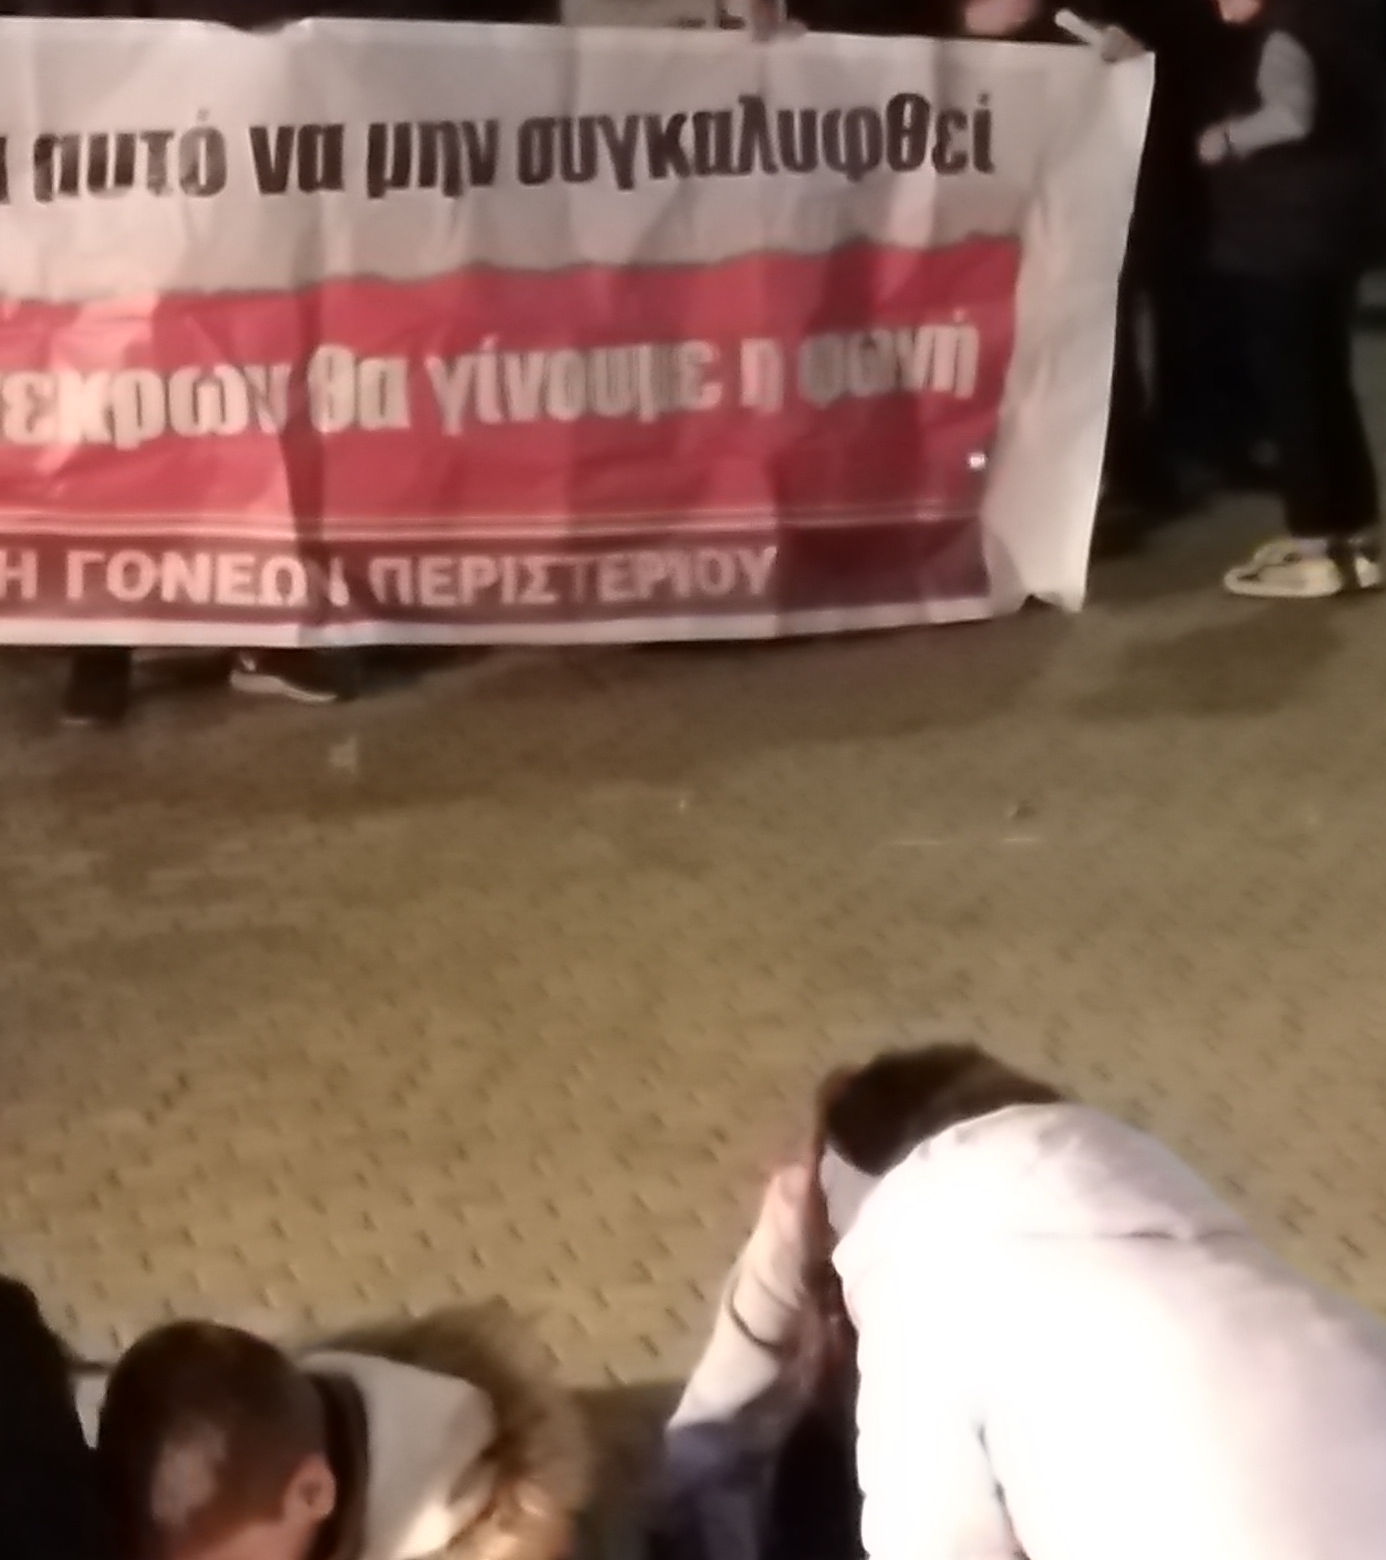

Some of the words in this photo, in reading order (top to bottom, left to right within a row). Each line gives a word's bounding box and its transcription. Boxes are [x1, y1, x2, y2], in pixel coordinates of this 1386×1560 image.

[31, 108, 230, 204] αυτό
[249, 121, 347, 196] να
[366, 118, 501, 199] μην
[515, 91, 997, 192] συγκαλυφθεί
[308, 342, 412, 435] θα
[424, 334, 723, 436] γίνουμε
[739, 337, 786, 417] η
[797, 307, 981, 410] φωνή
[367, 545, 780, 608] ΠΕΡΙΣΤΕΡΙΟΥ
